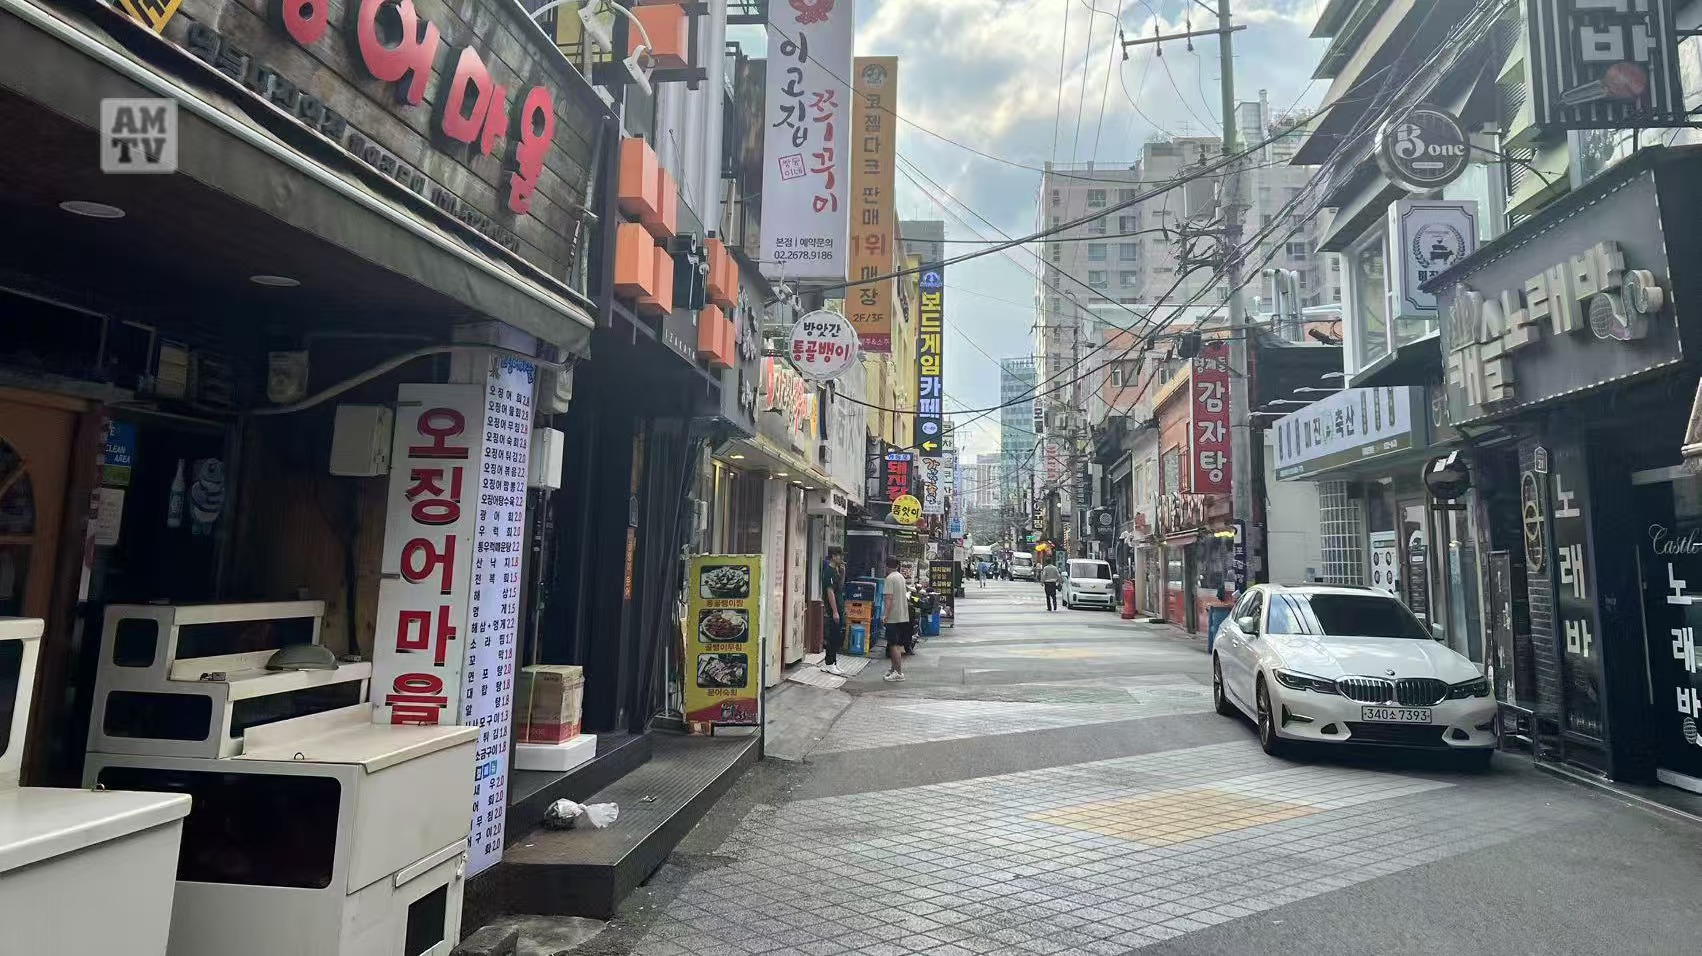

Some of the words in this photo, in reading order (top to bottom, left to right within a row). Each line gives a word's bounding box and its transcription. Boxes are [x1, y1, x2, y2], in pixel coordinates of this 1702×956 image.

[773, 32, 808, 147] 이고집
[1428, 144, 1465, 156] one
[775, 237, 793, 248] 본점
[799, 238, 834, 248] 예약문의
[774, 251, 833, 261] 02.2678.9186
[853, 313, 885, 322] 2F/3F
[803, 321, 842, 338] 방앗간
[792, 339, 850, 364] 통골뱅이
[1198, 381, 1227, 483] 감자탕
[385, 407, 469, 725] 오징어마을
[1366, 708, 1397, 720] 340소
[1398, 709, 1428, 721] 7393
